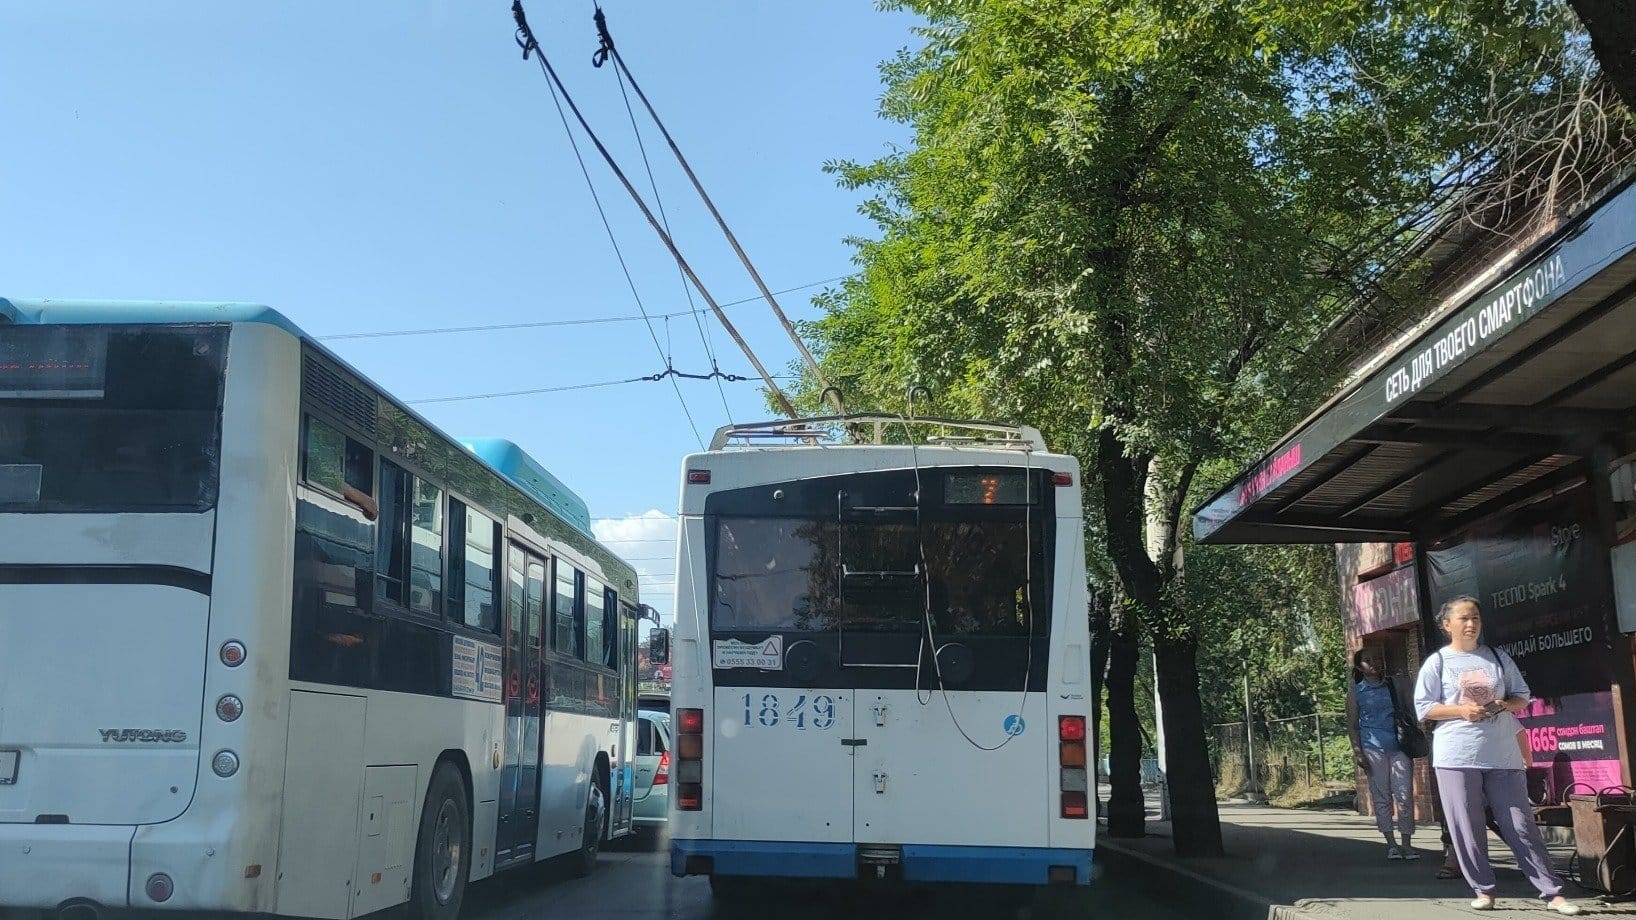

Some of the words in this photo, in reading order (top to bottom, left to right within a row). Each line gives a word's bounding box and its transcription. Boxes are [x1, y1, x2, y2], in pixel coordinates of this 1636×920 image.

[1386, 366, 1410, 402] СЕТЬ
[1411, 347, 1434, 392] ДЛЯ
[1434, 316, 1476, 369] ТВОЕГО
[1478, 254, 1566, 340] СМАРТФОНА
[981, 477, 997, 504] 7
[1528, 575, 1558, 602] Spark
[1558, 573, 1568, 591] 4
[1538, 626, 1593, 651] БОЛЬШЕГО
[741, 693, 836, 730] 1849
[98, 728, 187, 743] YUTONG
[1525, 726, 1558, 752] 1665
